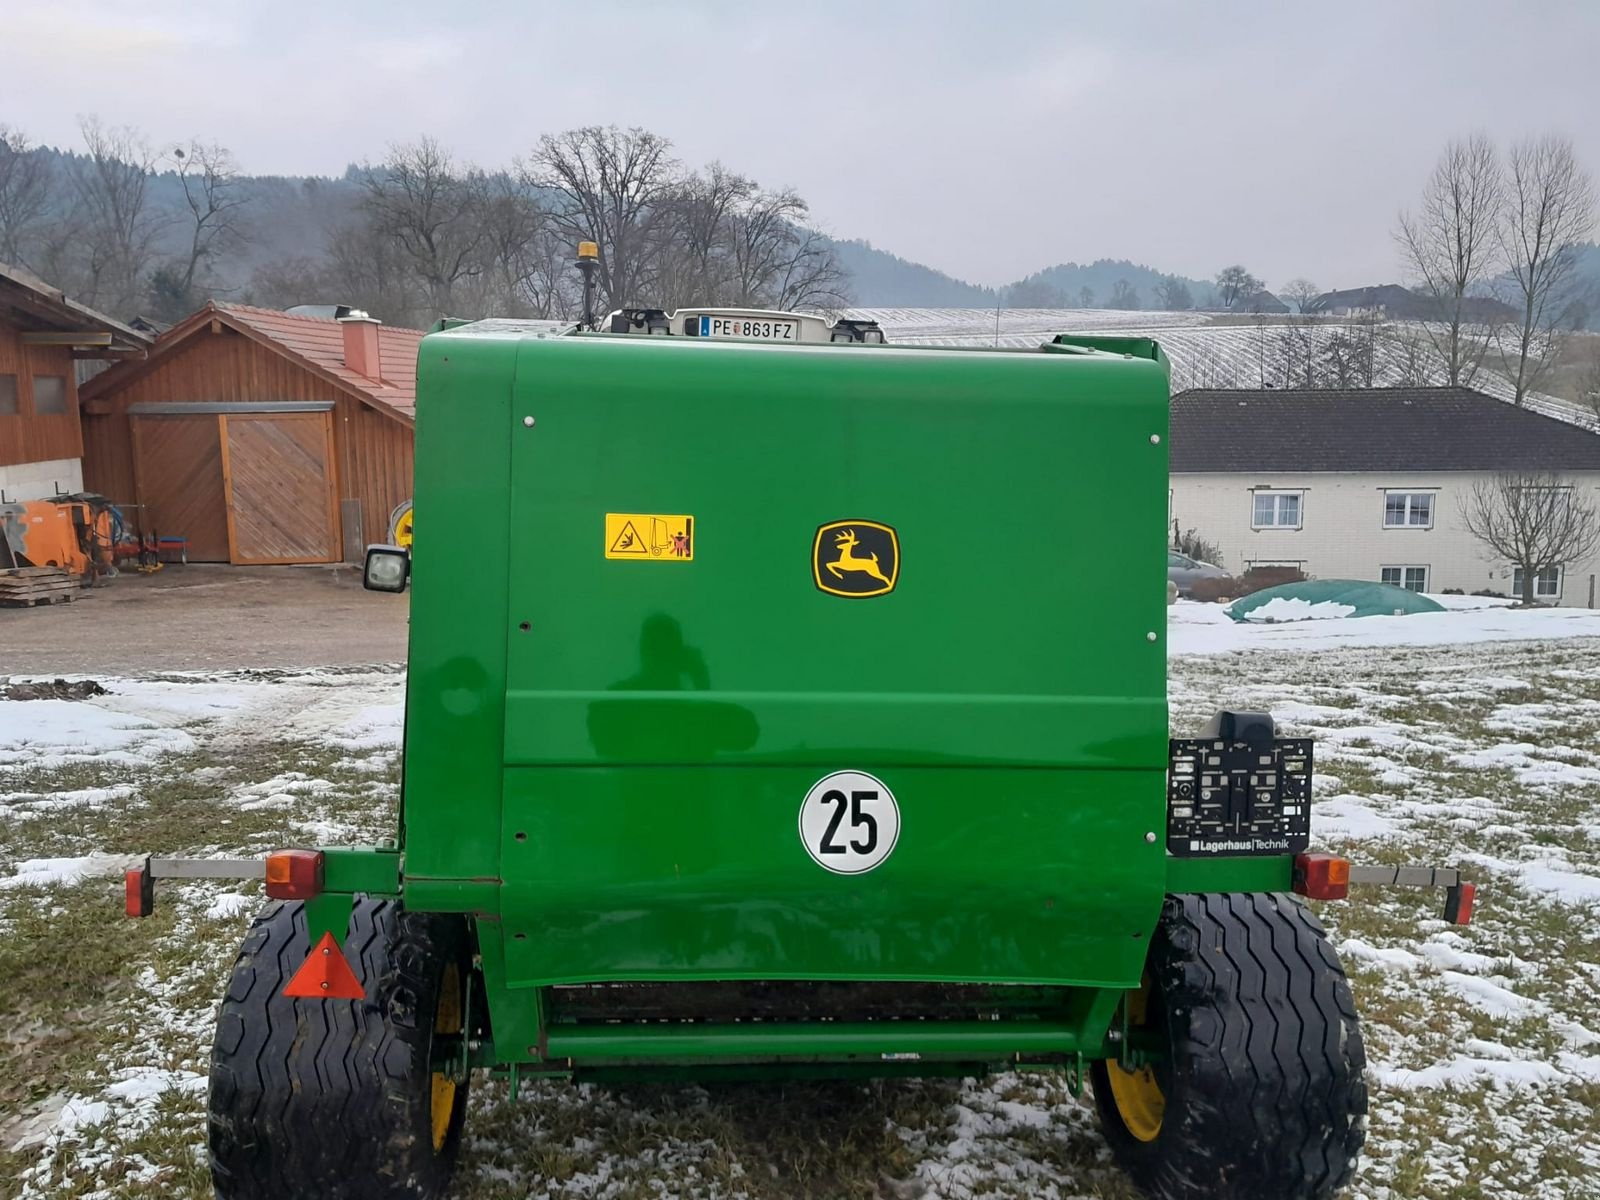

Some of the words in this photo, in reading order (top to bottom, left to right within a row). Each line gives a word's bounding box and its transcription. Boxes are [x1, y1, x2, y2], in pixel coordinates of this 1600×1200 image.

[713, 320, 731, 335] PE
[742, 321, 770, 338] 863
[773, 323, 792, 339] FZ
[820, 789, 879, 855] 25
